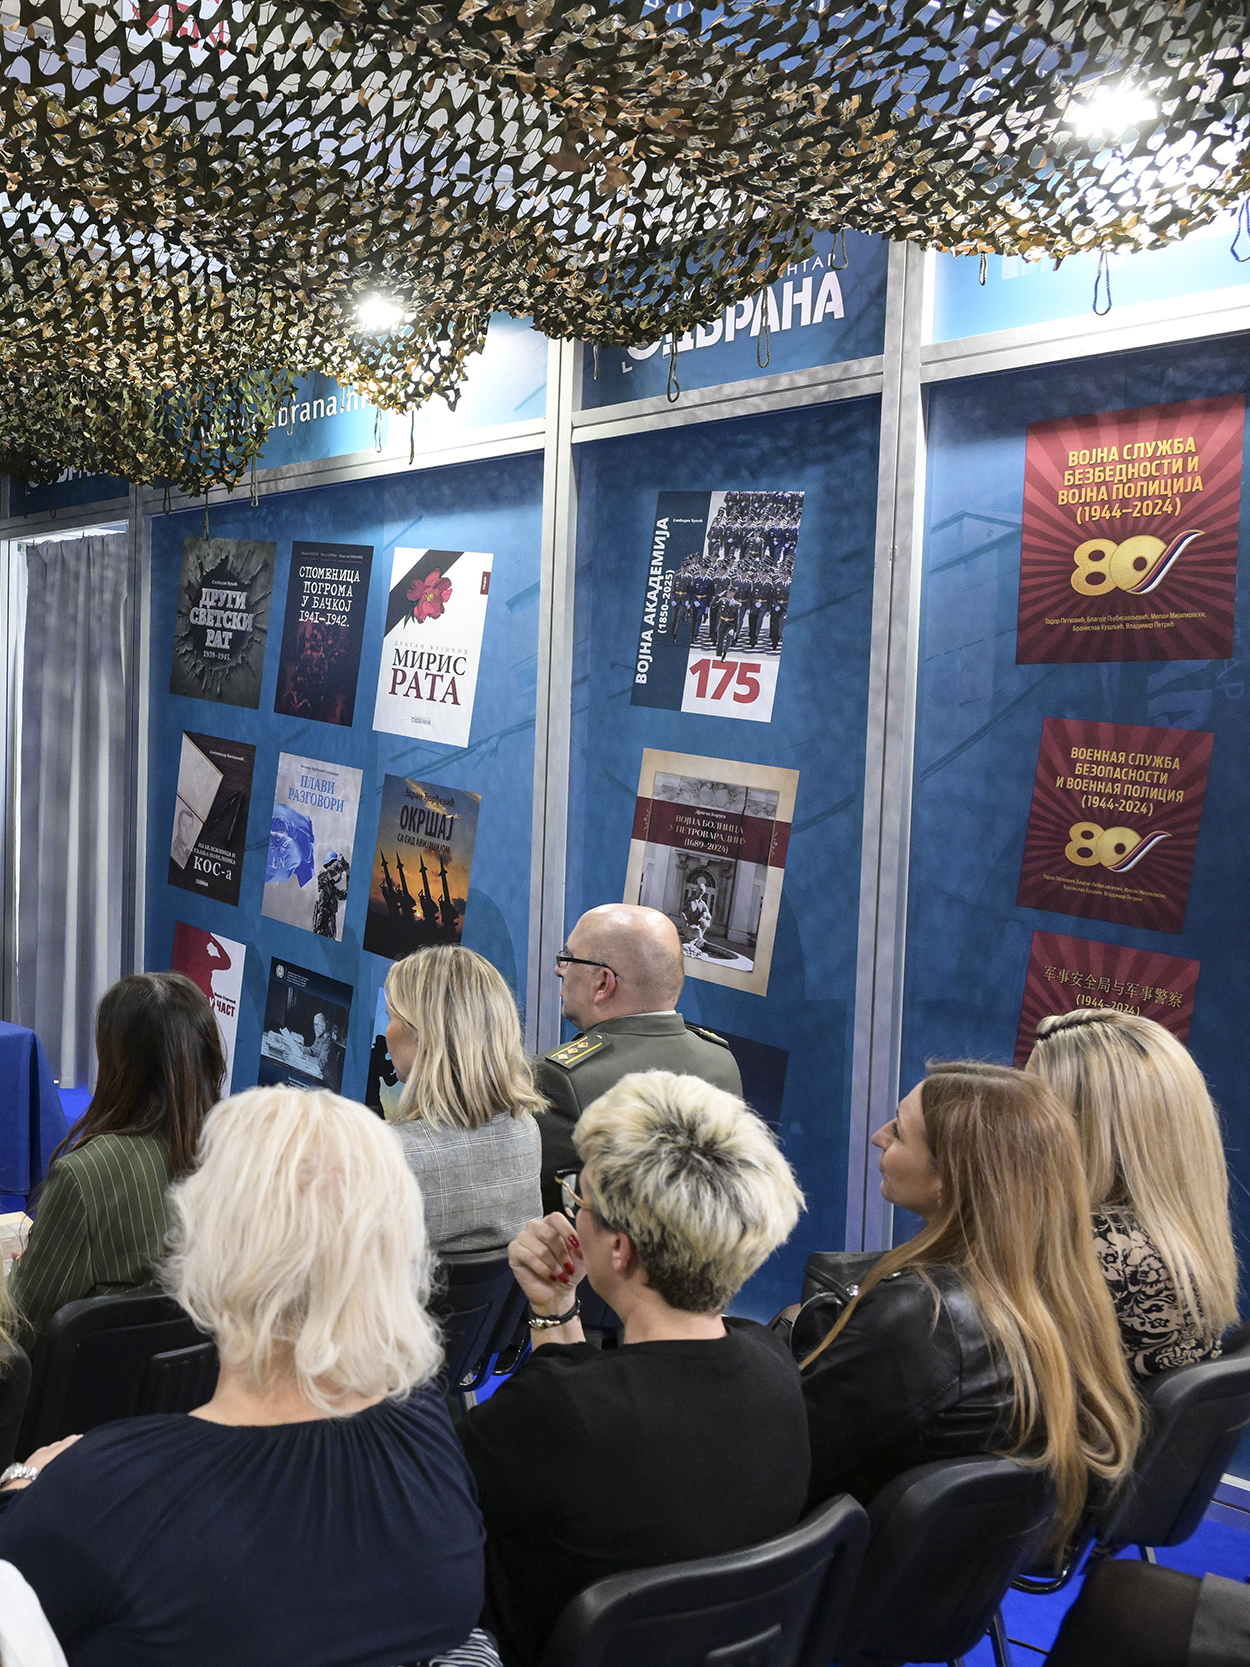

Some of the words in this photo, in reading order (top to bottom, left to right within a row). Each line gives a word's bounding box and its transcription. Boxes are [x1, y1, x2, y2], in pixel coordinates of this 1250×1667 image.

[1068, 445, 1120, 467] ВОЈНА
[1123, 436, 1197, 461] СЛУЖБА
[1064, 457, 1183, 486] БЕЗБЕДНОСТИ
[1187, 456, 1199, 473] И
[1058, 485, 1109, 506] ВОЈНА
[1112, 475, 1204, 500] ПОЛИЦИЈА
[299, 566, 361, 583] СПОМЕНИЦА
[643, 516, 670, 626] АКАДЕМИЈА
[1070, 534, 1168, 597] 80
[199, 588, 247, 610] ДРУГИ
[303, 581, 354, 597] ПОГРОМА
[301, 595, 309, 607] У
[312, 596, 352, 612] БАЧКОЈ
[190, 606, 255, 632] СВЕТСКИ
[1126, 621, 1153, 631] Владимир
[205, 629, 233, 650] РАТ
[394, 640, 425, 649] ДРАГАН
[392, 648, 467, 676] МИРИС
[635, 629, 654, 684] ВОЈНА
[388, 667, 461, 706] РАТА
[689, 658, 761, 704] 175
[1070, 747, 1126, 764] ВОЕННАЯ
[1128, 752, 1180, 770] СЛУЖБА
[300, 775, 335, 795] ПЛАВИ
[1075, 762, 1169, 785] БЕЗОПАСНОСТИ
[288, 787, 345, 813] РАЗГОВОРИ
[405, 788, 422, 800] Зоран
[424, 792, 455, 807] Ђорђевић
[1055, 776, 1064, 788] И
[1066, 777, 1121, 795] ВОЕННАЯ
[1123, 784, 1185, 803] ПОЛИЦИЯ
[1081, 794, 1153, 817] (1944-2024)
[399, 804, 454, 841] ОКРШАЈ
[397, 833, 404, 842] СА
[1064, 821, 1143, 868] 80
[193, 855, 232, 881] КОС-а
[272, 857, 285, 869] UN
[1043, 965, 1184, 1008] 军事安全局与军事警察
[216, 1002, 236, 1018] ЧАСТ
